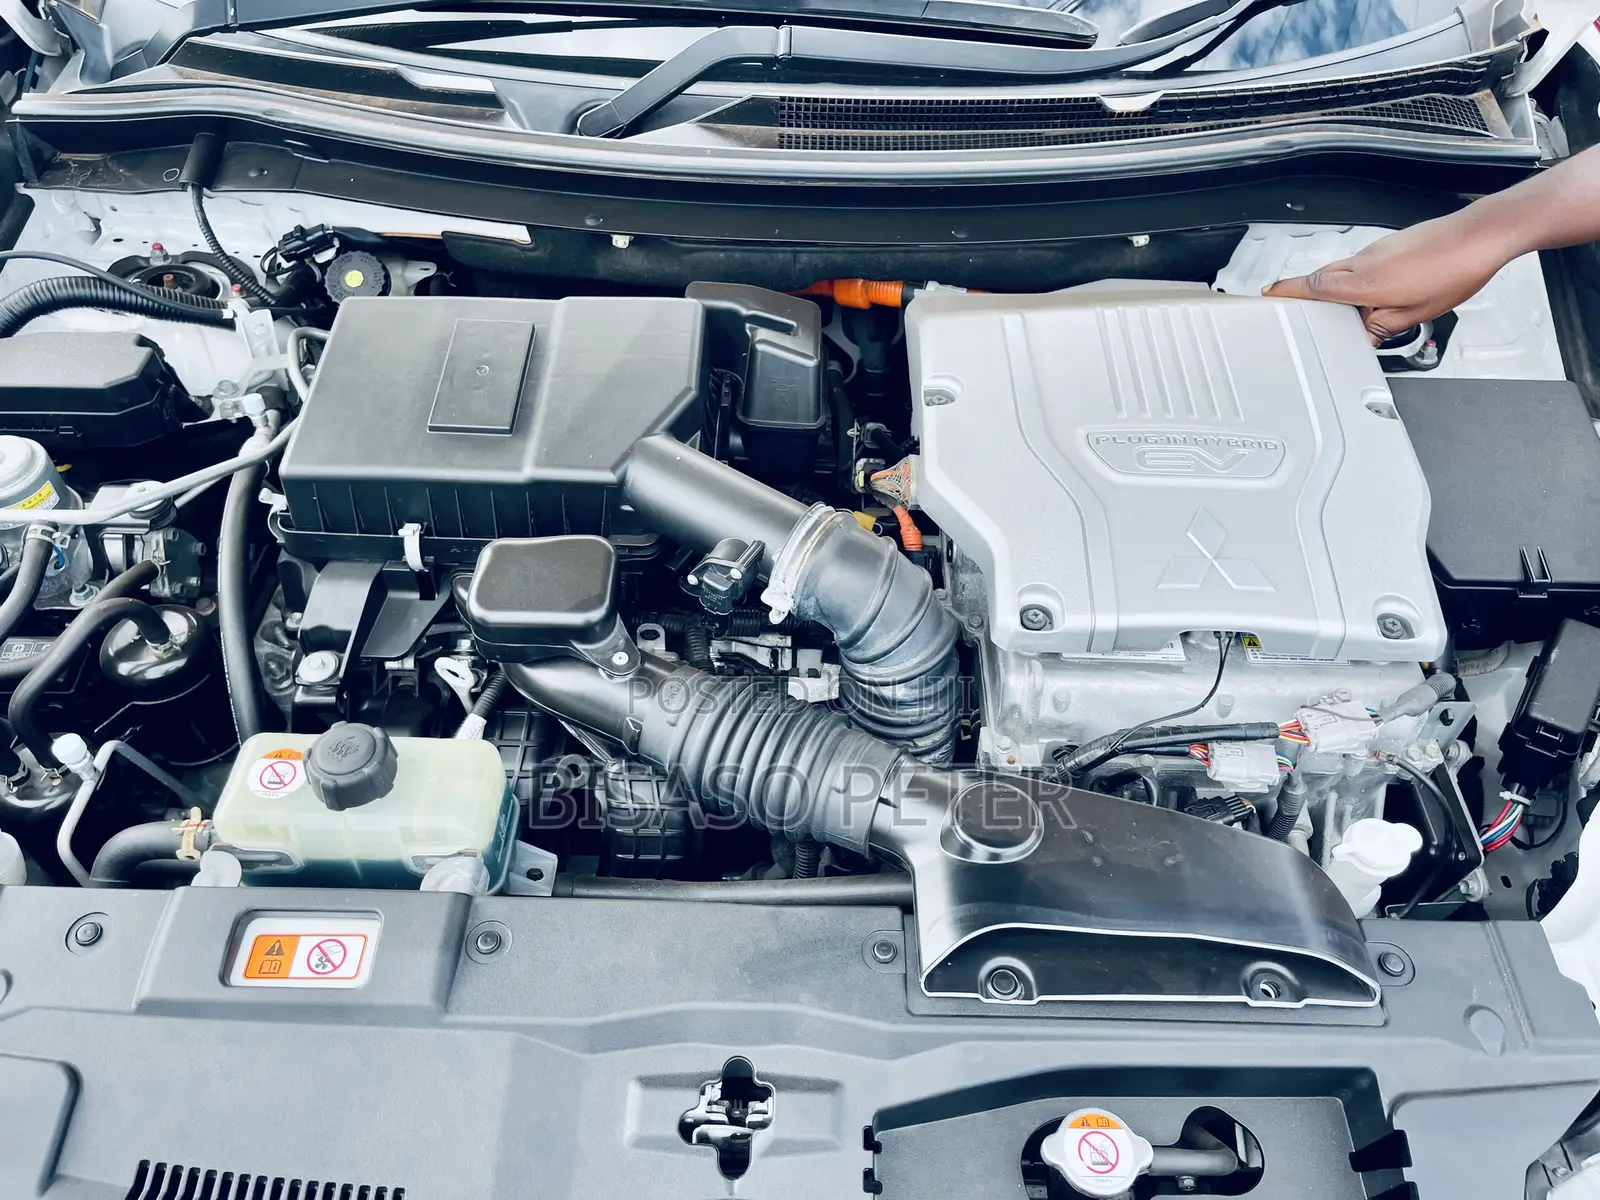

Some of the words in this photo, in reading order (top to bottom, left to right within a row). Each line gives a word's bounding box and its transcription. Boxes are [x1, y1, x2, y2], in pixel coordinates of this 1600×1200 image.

[1095, 434, 1189, 445] PLUG-IN
[1194, 434, 1279, 450] HYBRID
[1135, 445, 1254, 473] EV
